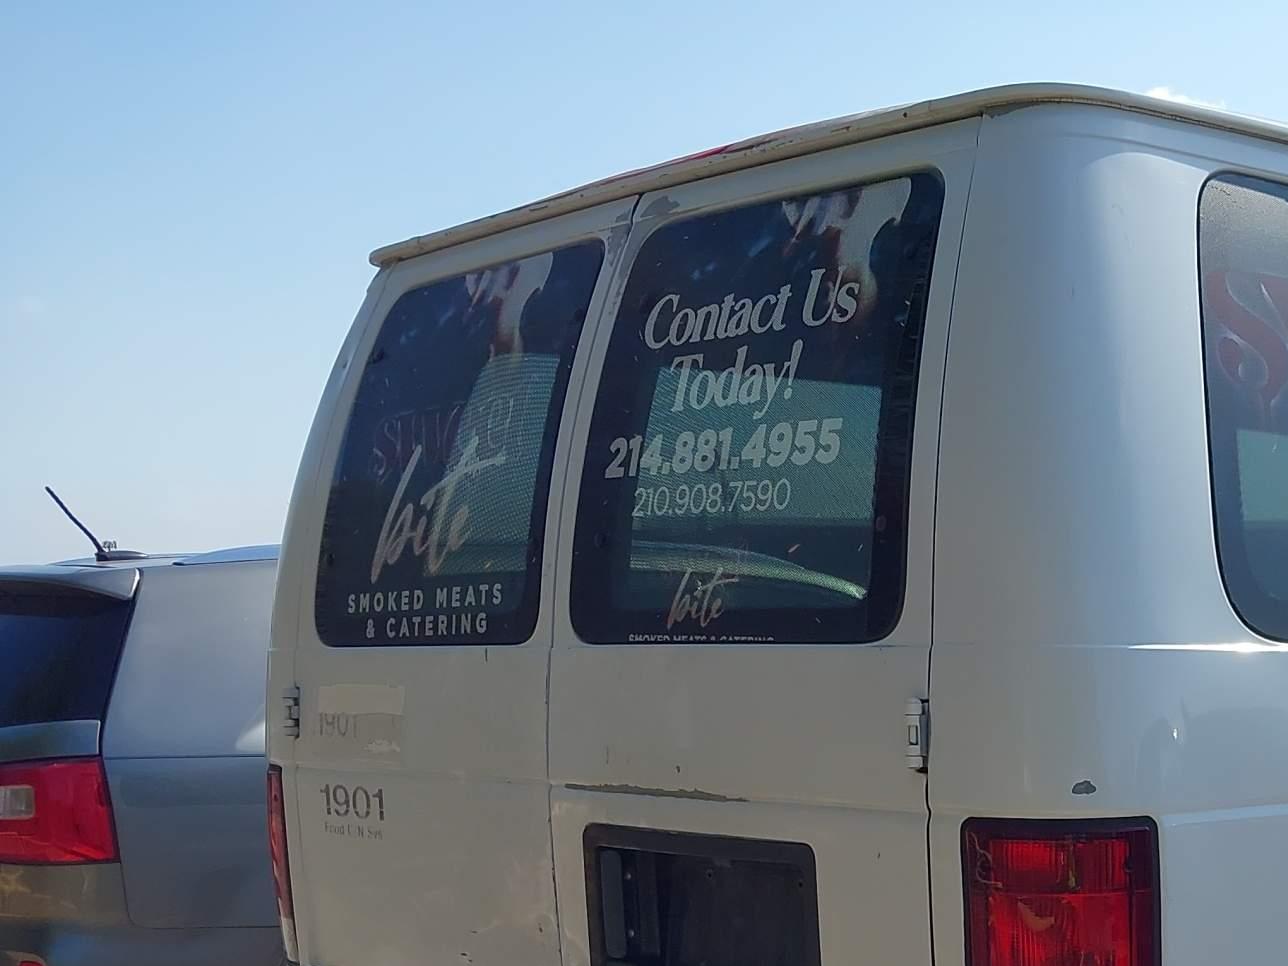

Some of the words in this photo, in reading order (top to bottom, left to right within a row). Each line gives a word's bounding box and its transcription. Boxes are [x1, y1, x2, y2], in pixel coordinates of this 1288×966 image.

[644, 284, 792, 349] Contact
[802, 265, 860, 327] Us
[671, 338, 804, 420] Today!
[605, 417, 843, 479] 214.881.4955
[371, 437, 506, 584] bite
[632, 479, 791, 516] 210.908.7590
[348, 589, 423, 613] SMOKED
[436, 584, 502, 608] MEATS
[366, 619, 375, 638] &
[386, 612, 487, 637] CATERING
[667, 568, 739, 630] bite
[320, 784, 384, 821] 1901
